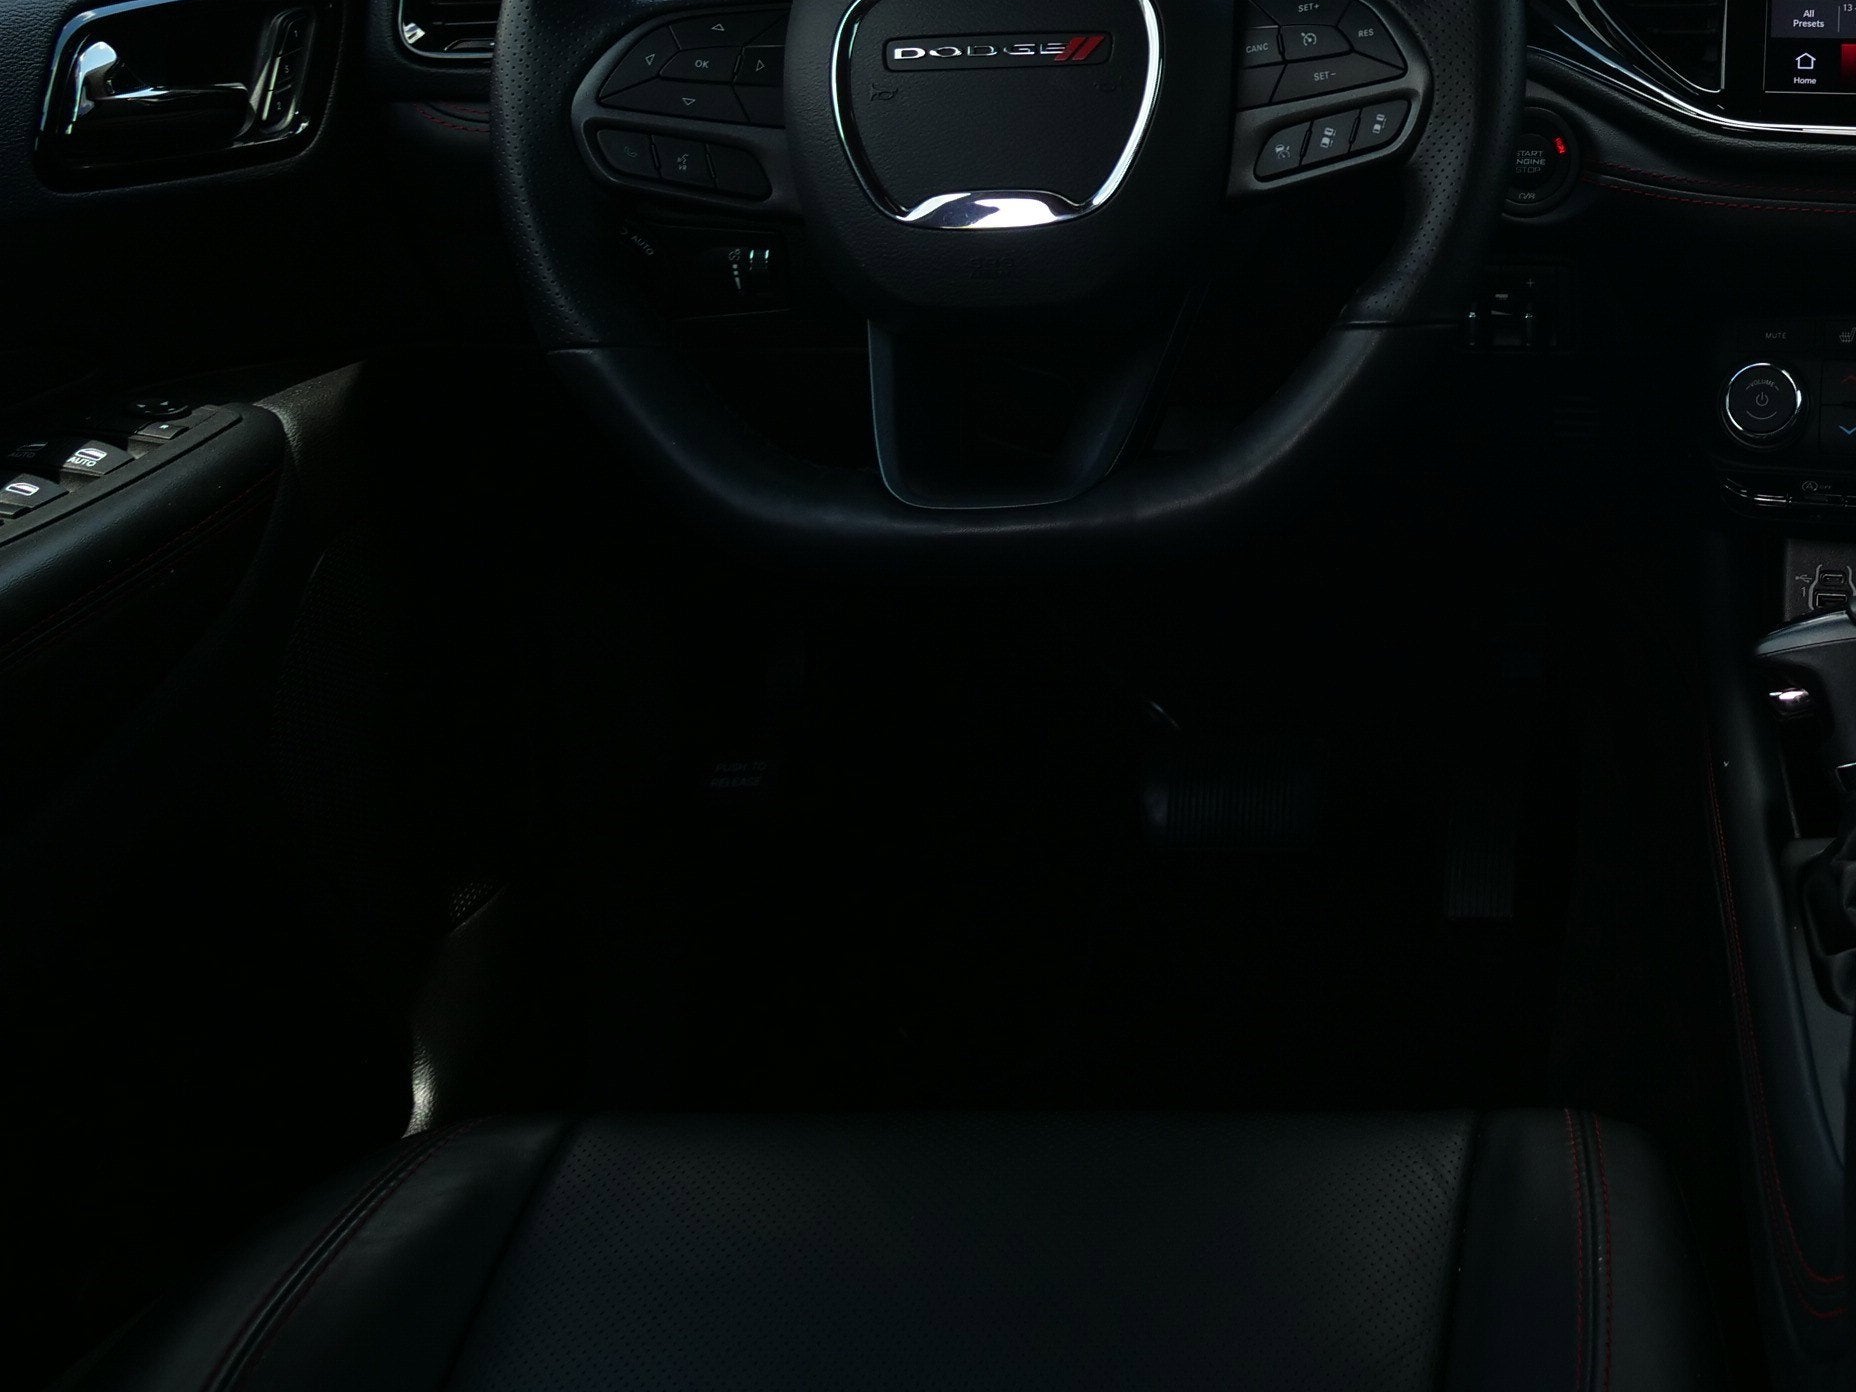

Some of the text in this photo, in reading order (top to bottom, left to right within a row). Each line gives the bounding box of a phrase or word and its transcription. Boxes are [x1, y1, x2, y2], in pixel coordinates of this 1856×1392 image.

[1297, 3, 1320, 13] SET+
[1803, 10, 1815, 18] All
[1793, 19, 1825, 28] Presets
[1357, 28, 1375, 38] RES
[894, 42, 1069, 60] DODGE
[1245, 42, 1269, 54] CANC
[694, 59, 710, 69] OK
[1793, 77, 1817, 85] Home
[1515, 166, 1541, 174] STOP
[630, 234, 655, 256] AUTO
[1765, 332, 1787, 340] MUTE
[1749, 378, 1775, 387] VOLUME
[70, 456, 97, 467] AUTO
[1800, 587, 1807, 597] 1
